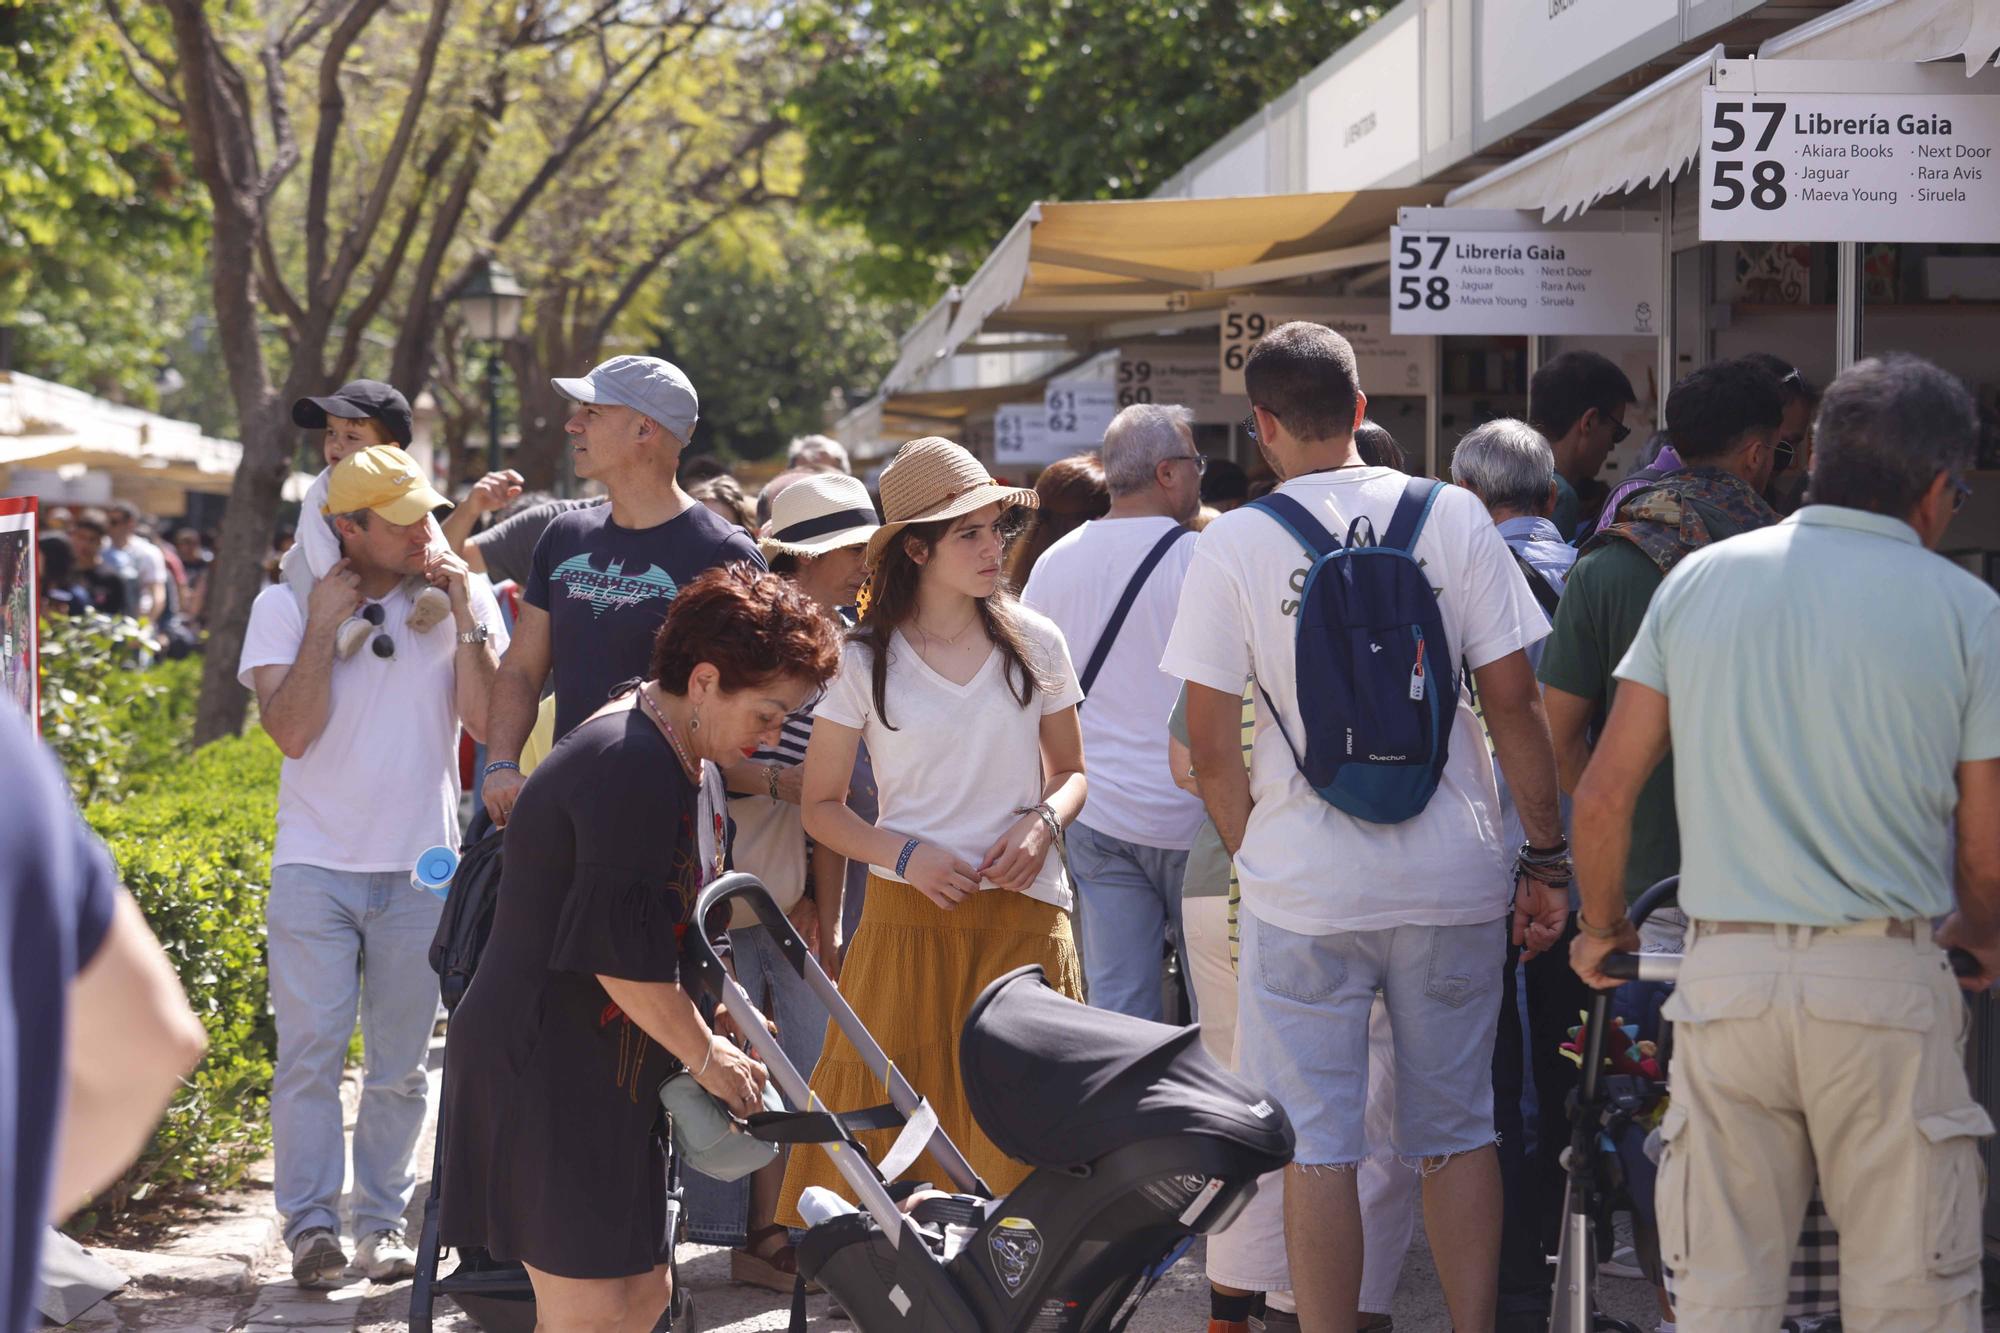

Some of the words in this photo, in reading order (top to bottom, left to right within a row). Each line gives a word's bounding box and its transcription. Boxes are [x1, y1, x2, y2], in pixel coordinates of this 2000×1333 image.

[1711, 102, 1787, 152] 57
[1795, 113, 1890, 135] Librería
[1897, 114, 1952, 135] Gaia
[1802, 144, 1846, 158] Akiara
[1850, 144, 1894, 158] Books
[1918, 144, 1952, 158] Next
[1955, 144, 1992, 158] Door
[1801, 166, 1850, 182] Jaguar
[1918, 167, 1950, 180] Rara
[1953, 167, 1982, 180] Avis
[1711, 160, 1787, 211] 58
[1801, 188, 1848, 201] Maeva
[1851, 188, 1897, 204] Young
[1917, 188, 1966, 201] Siruela
[1398, 236, 1451, 270] 57
[1456, 244, 1522, 260] Librería
[1527, 246, 1566, 261] Gaia
[1460, 265, 1492, 276] Akiara
[1494, 265, 1525, 276] Books
[1541, 266, 1564, 276] Next
[1567, 267, 1592, 277] Door
[1398, 276, 1451, 311] 58
[1460, 280, 1494, 292] Jaguar
[1541, 281, 1563, 292] Rara
[1565, 282, 1586, 292] Avis
[1460, 296, 1493, 306] Maeva
[1495, 296, 1528, 308] Young
[1541, 296, 1575, 307] Siruela
[1225, 313, 1266, 340] 59
[1225, 345, 1254, 370] 6
[1119, 361, 1151, 383] 59
[1049, 391, 1074, 411] 61
[1119, 386, 1151, 407] 60
[1049, 413, 1077, 432] 62
[560, 570, 620, 590] GOTHAM
[624, 578, 671, 598] CITY
